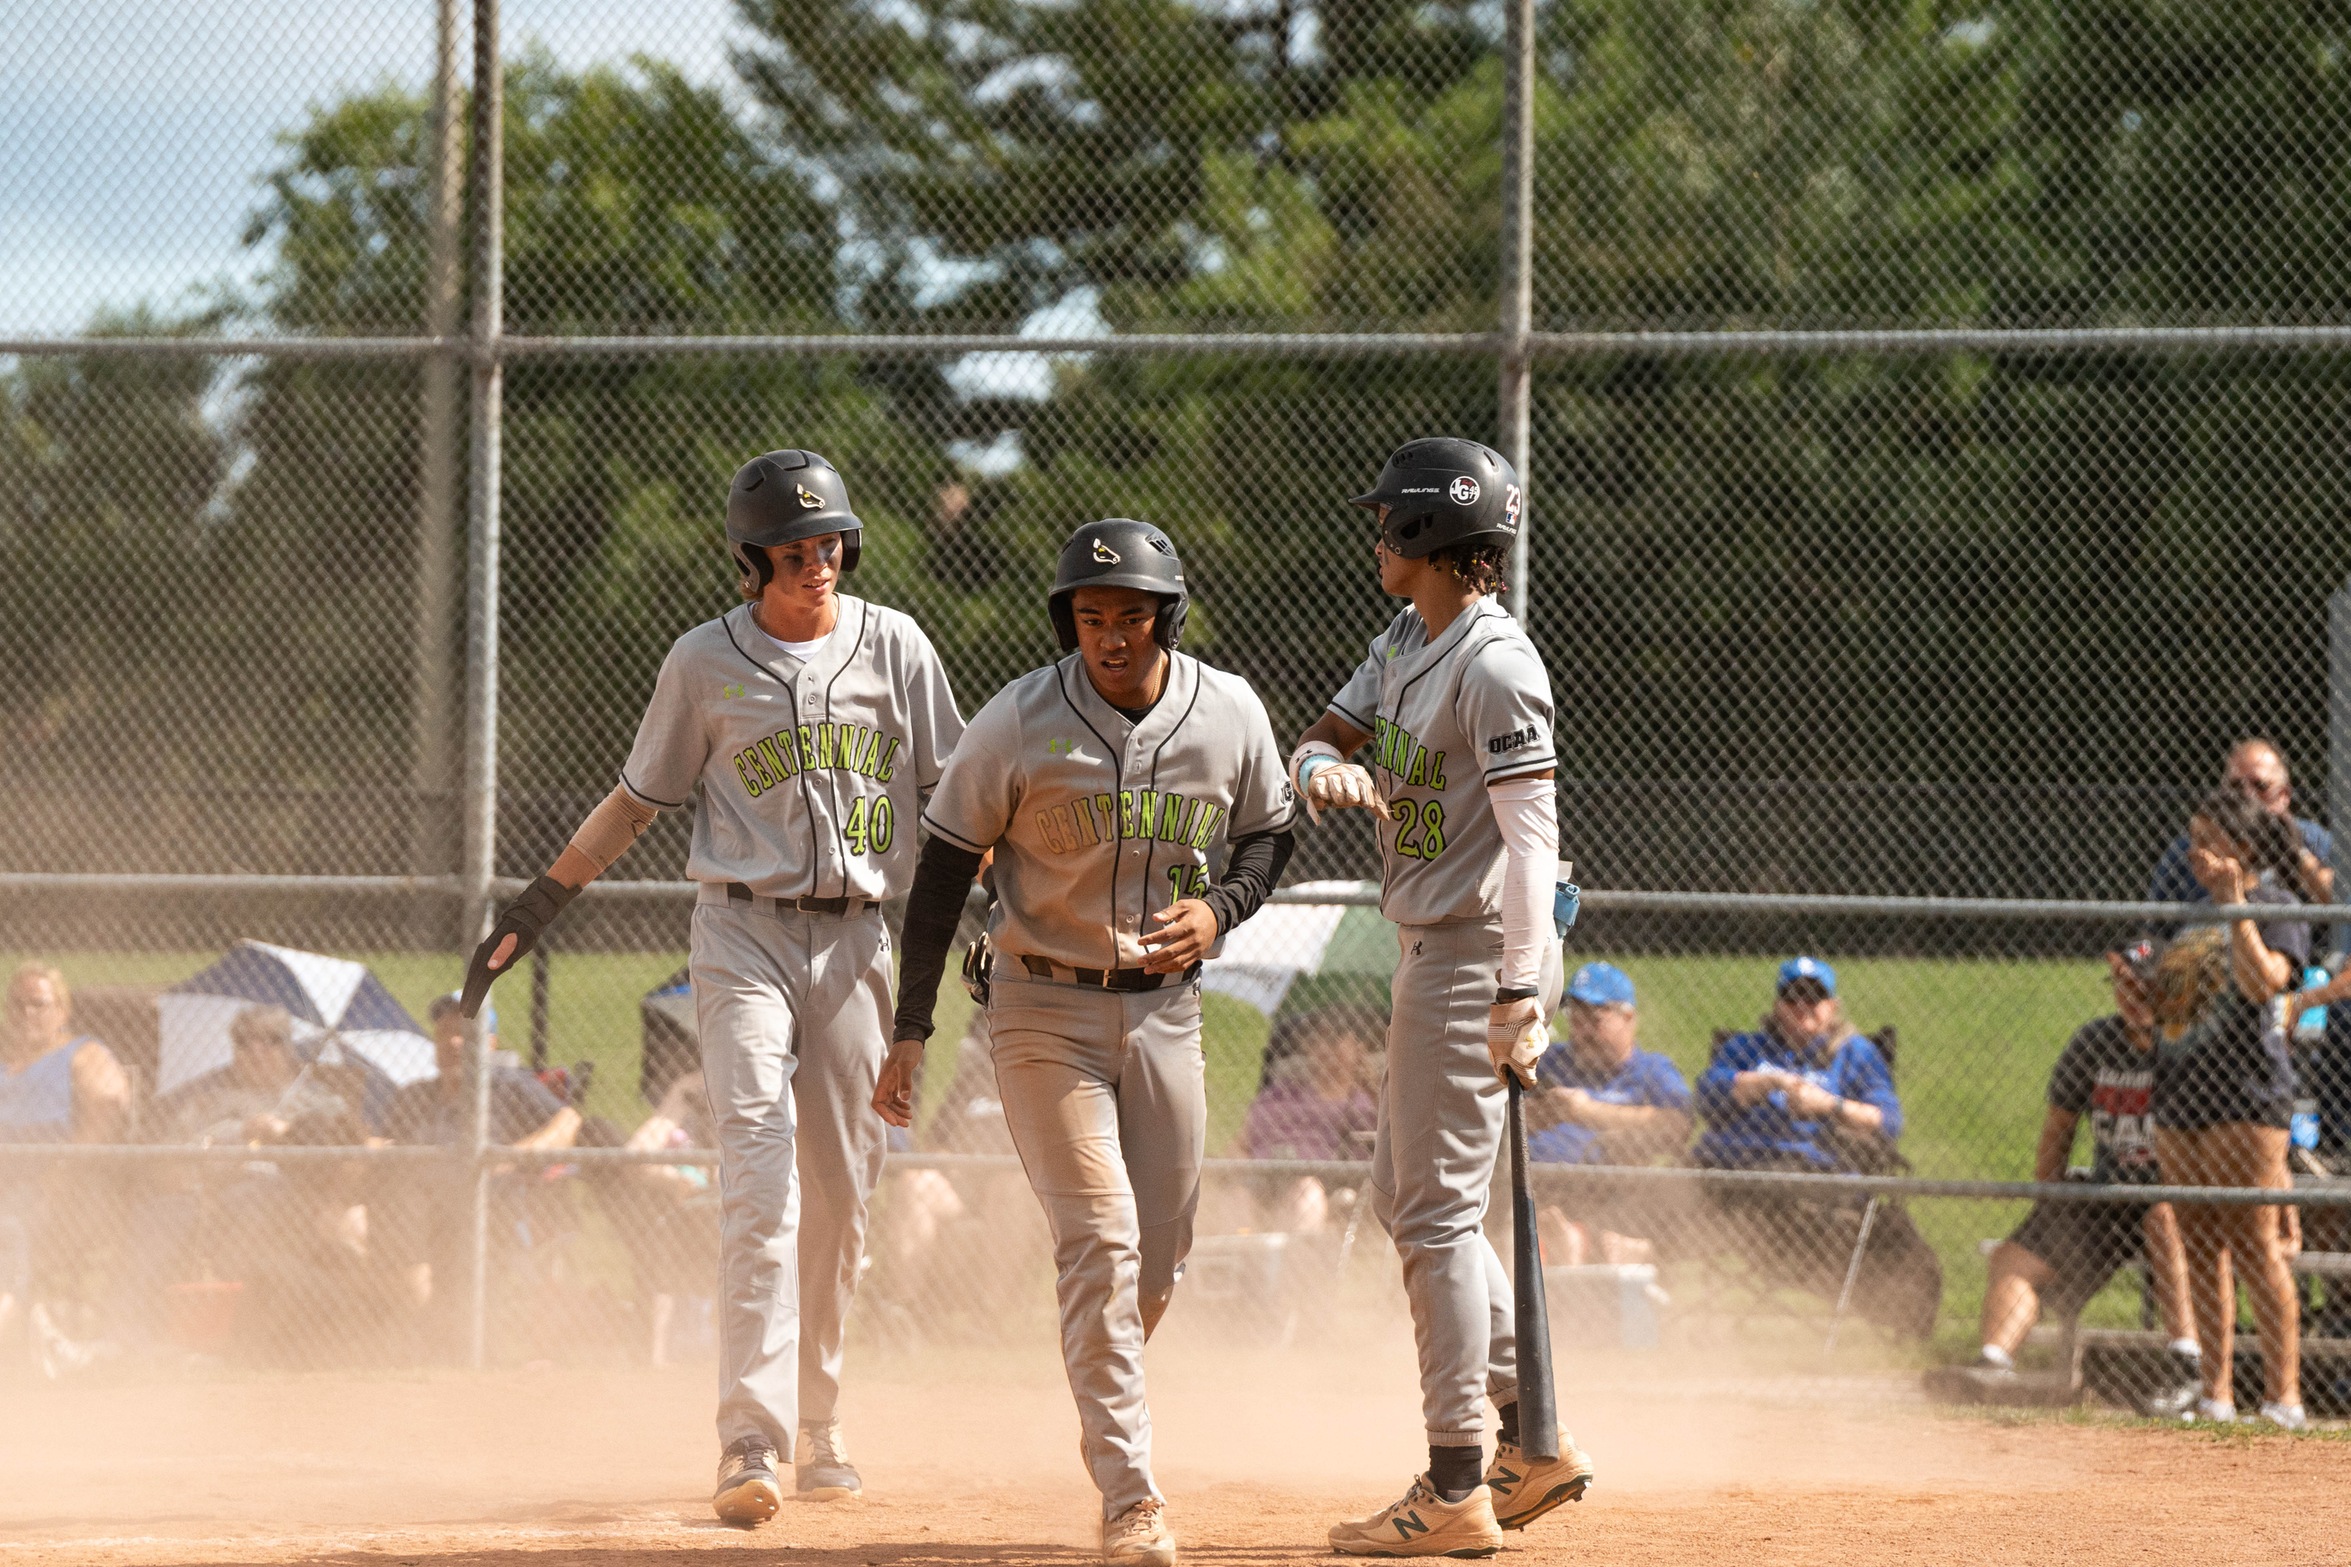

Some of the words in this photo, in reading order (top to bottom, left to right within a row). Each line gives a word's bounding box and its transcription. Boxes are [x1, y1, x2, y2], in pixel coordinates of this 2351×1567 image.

[1506, 483, 1521, 516] 23
[733, 722, 899, 797] CENTENNIAL
[1488, 724, 1540, 755] OCAA
[845, 795, 894, 855] 40
[1389, 797, 1446, 861] 28
